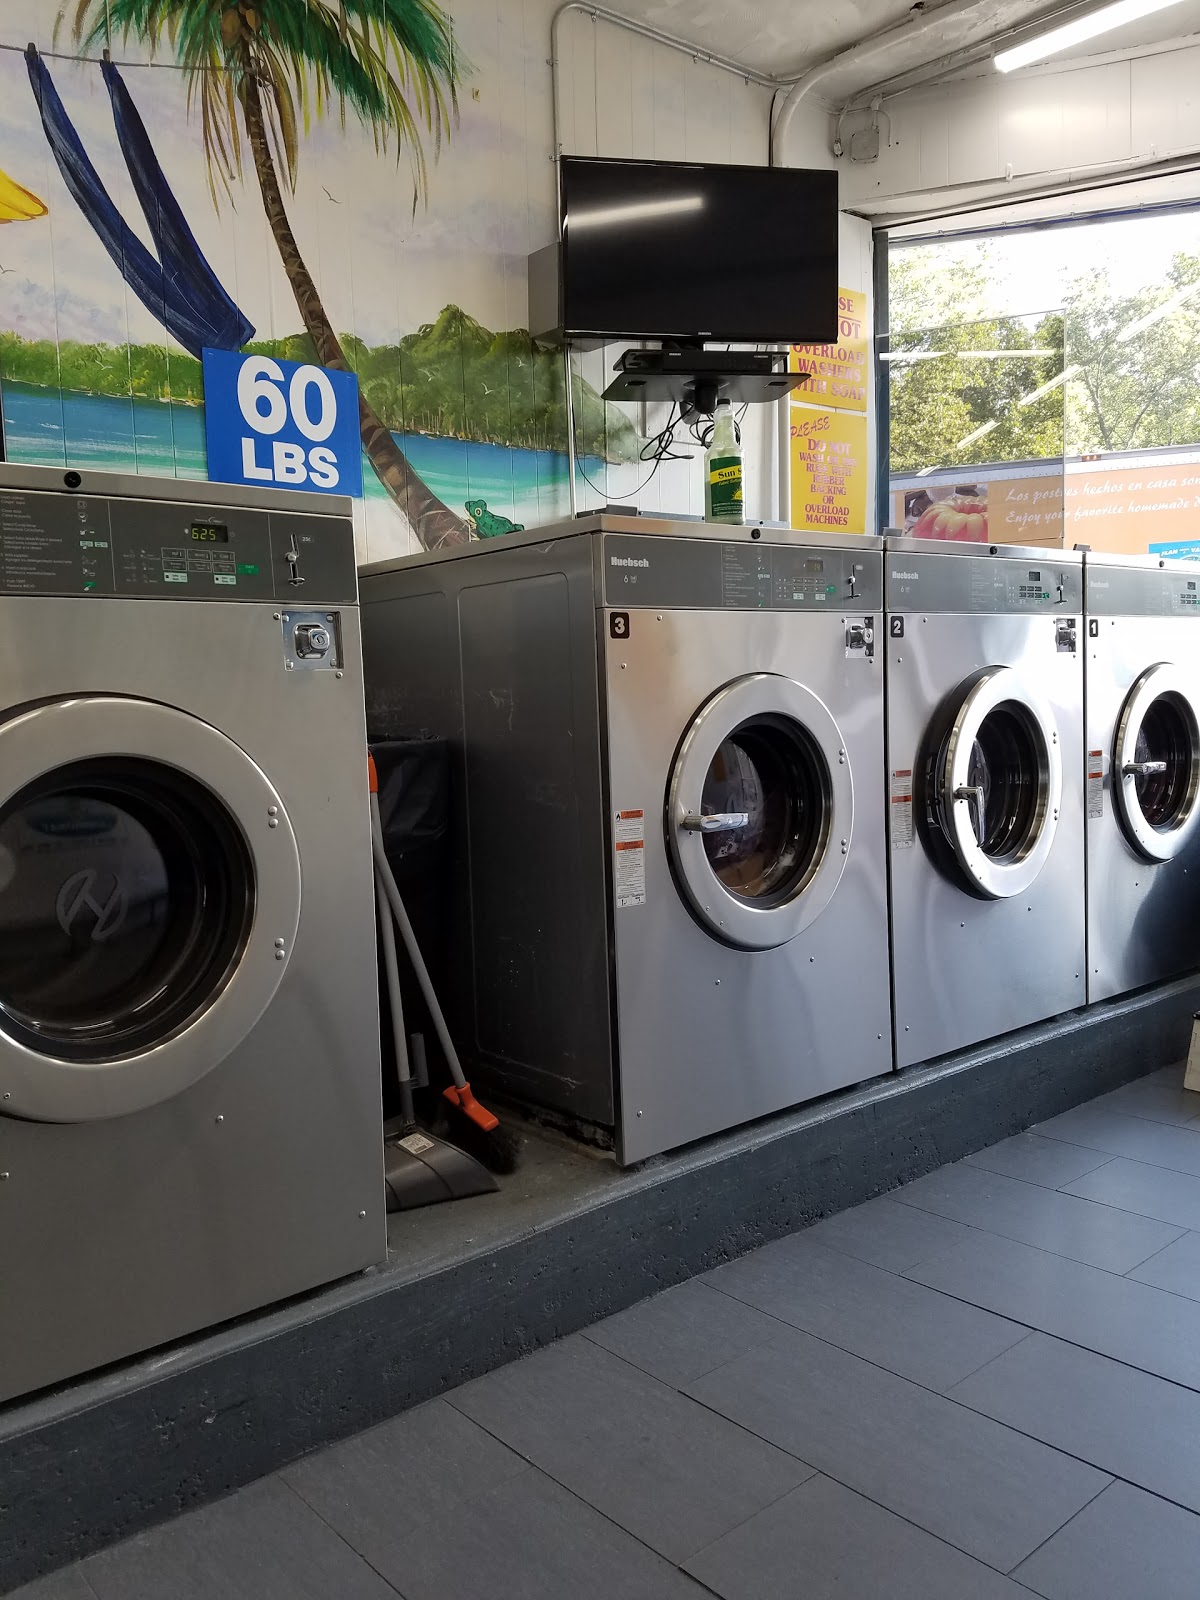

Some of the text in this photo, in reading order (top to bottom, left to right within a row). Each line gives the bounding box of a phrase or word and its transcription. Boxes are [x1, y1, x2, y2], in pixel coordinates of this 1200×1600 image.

[839, 320, 861, 339] OT
[792, 344, 865, 365] OVERLOAD
[797, 357, 860, 383] WASHERS
[237, 355, 337, 442] 60
[830, 381, 866, 401] SOAP
[790, 416, 831, 439] PLEASE
[807, 438, 827, 453] DO
[241, 437, 340, 488] LBS
[799, 451, 824, 463] WASH
[718, 470, 736, 480] Sun
[813, 473, 845, 486] RUBBER
[810, 484, 847, 496] BACKING
[1004, 488, 1029, 502] Los
[1083, 480, 1124, 496] hechos
[1127, 481, 1143, 491] en
[1146, 478, 1177, 489] casa
[822, 495, 835, 505] OR
[804, 504, 850, 516] OVERLOAD
[1005, 510, 1042, 527] Enjoy
[1074, 505, 1124, 522] favorite
[1127, 497, 1190, 513] homemade
[805, 514, 848, 526] MACHINES
[191, 528, 216, 541] 625
[610, 556, 649, 567] Huebsch
[892, 571, 919, 579] Huebsch
[614, 616, 625, 634] 3
[893, 620, 901, 634] 2
[1090, 620, 1097, 635] 1
